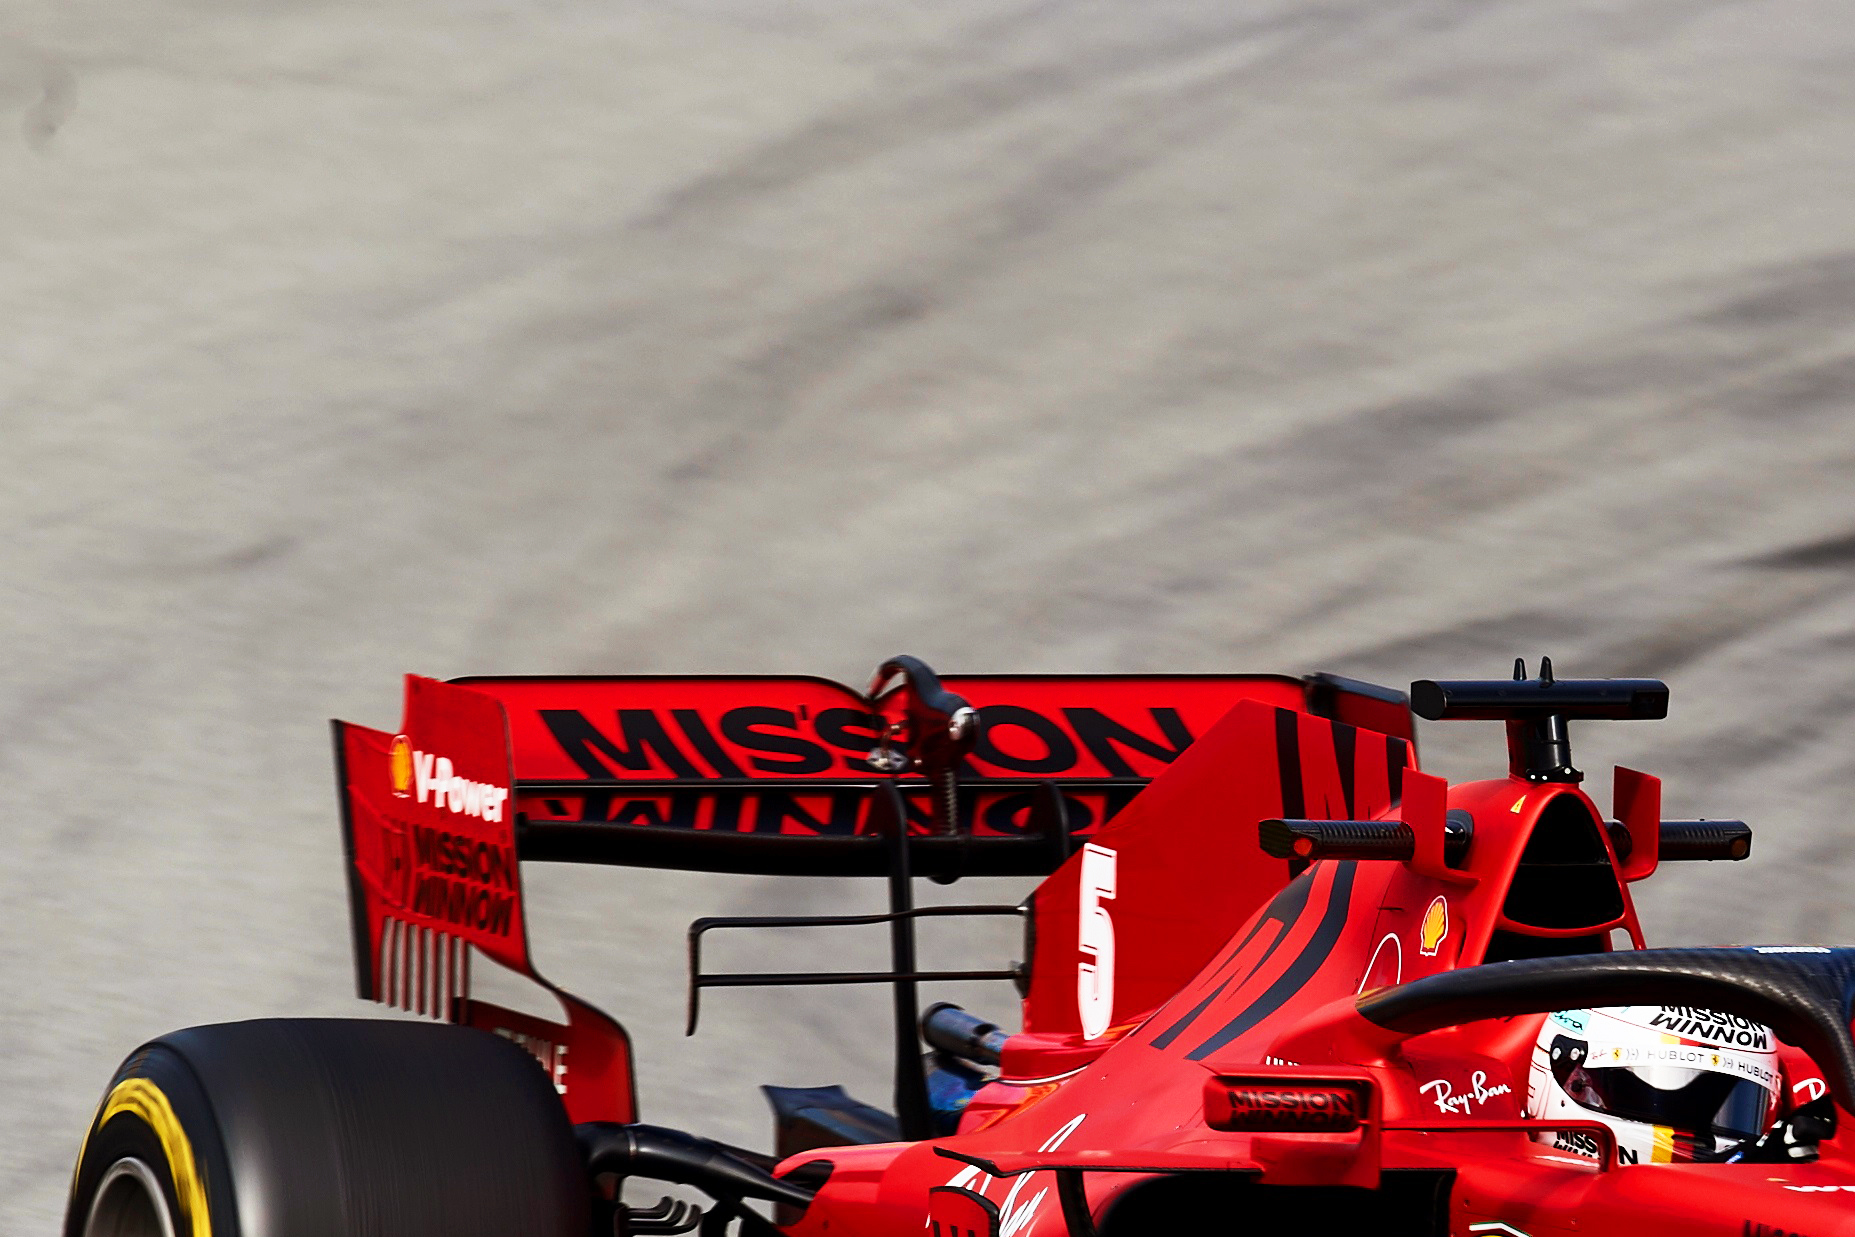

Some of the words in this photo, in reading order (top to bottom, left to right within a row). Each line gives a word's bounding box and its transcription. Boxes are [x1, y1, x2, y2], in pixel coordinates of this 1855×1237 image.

[538, 706, 1196, 779] MISSON
[413, 750, 508, 823] V-Power
[1078, 843, 1117, 1041] 5
[1649, 1013, 1768, 1050] WINNOW
[1647, 1051, 1704, 1064] HUBLOT
[1738, 1062, 1776, 1083] HUBLOT
[1229, 1091, 1355, 1113] MISSION
[1556, 1130, 1639, 1165] MISSN
